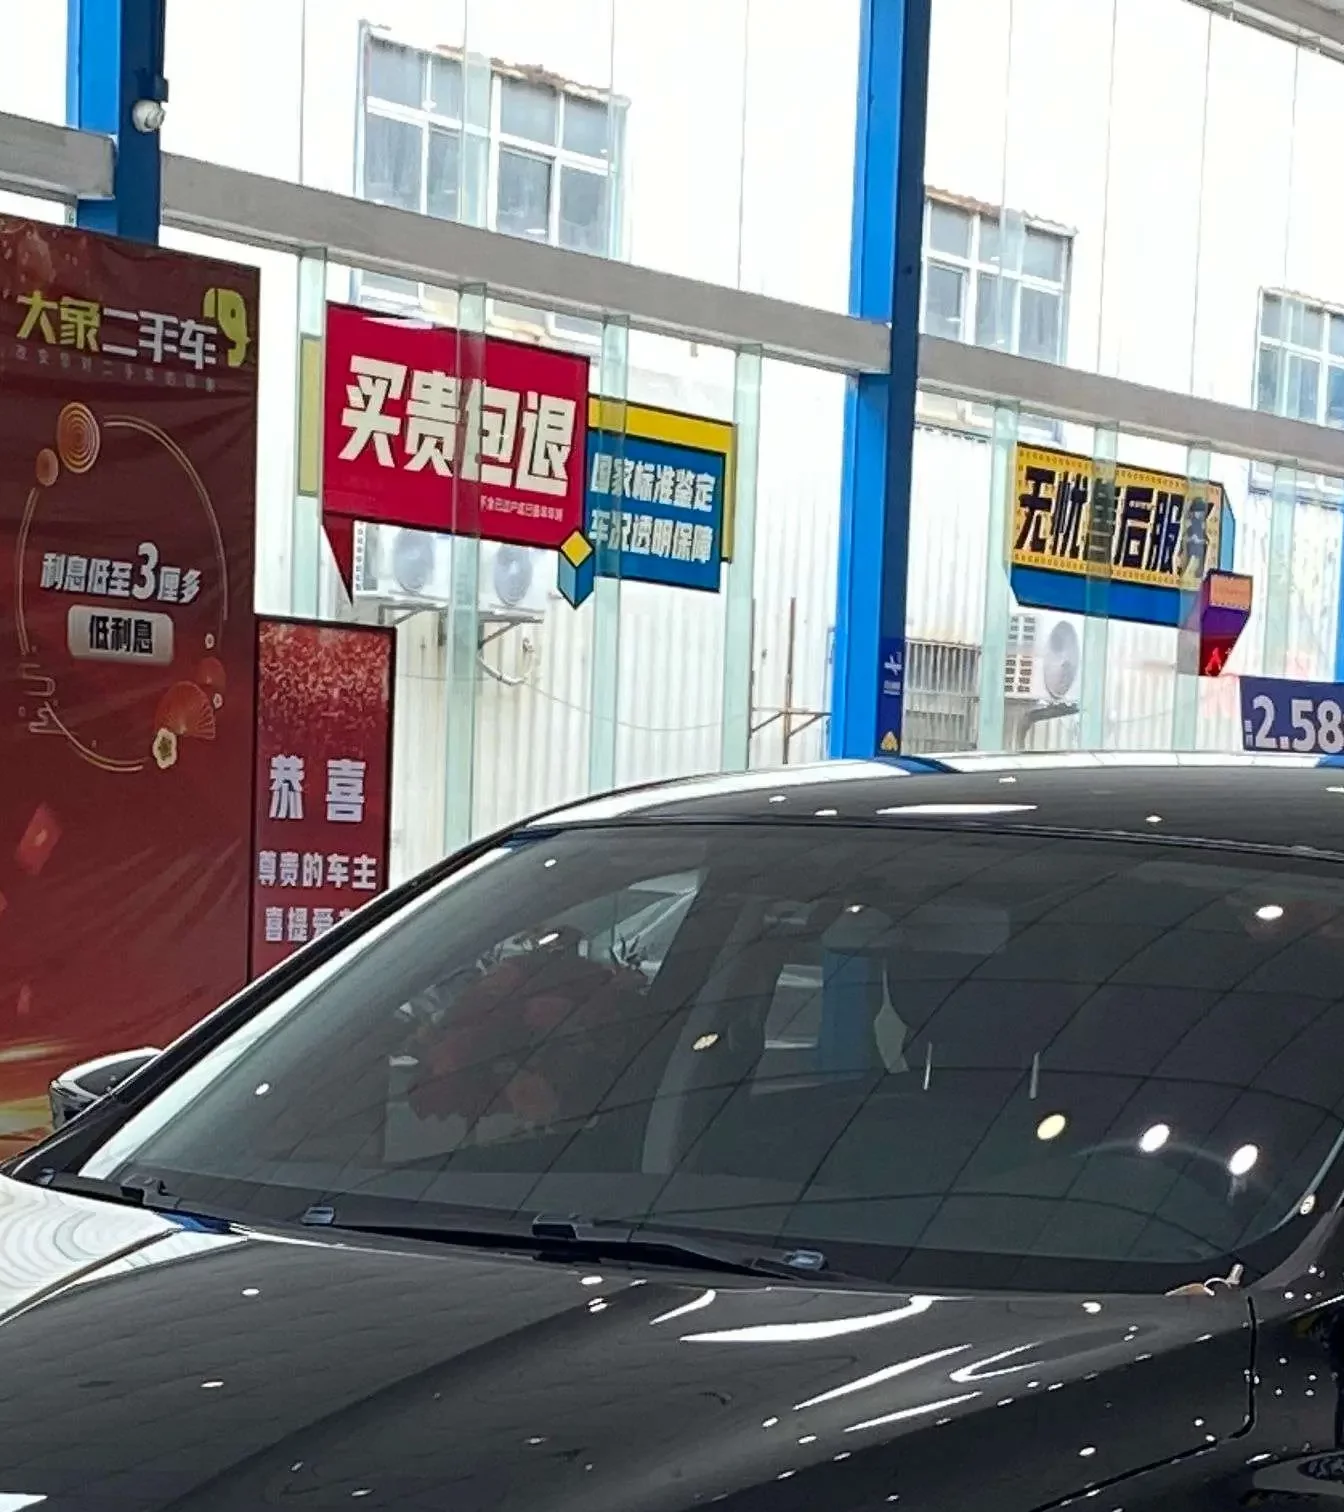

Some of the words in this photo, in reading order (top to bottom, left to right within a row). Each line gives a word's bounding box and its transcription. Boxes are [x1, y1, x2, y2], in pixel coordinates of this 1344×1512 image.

[17, 290, 217, 370] 大象二手车
[339, 355, 576, 497] 买贵包退
[90, 614, 153, 654] 低利息
[269, 755, 366, 823] 恭喜
[258, 851, 377, 890] 尊贵的车主
[266, 906, 355, 941] 喜提爱
